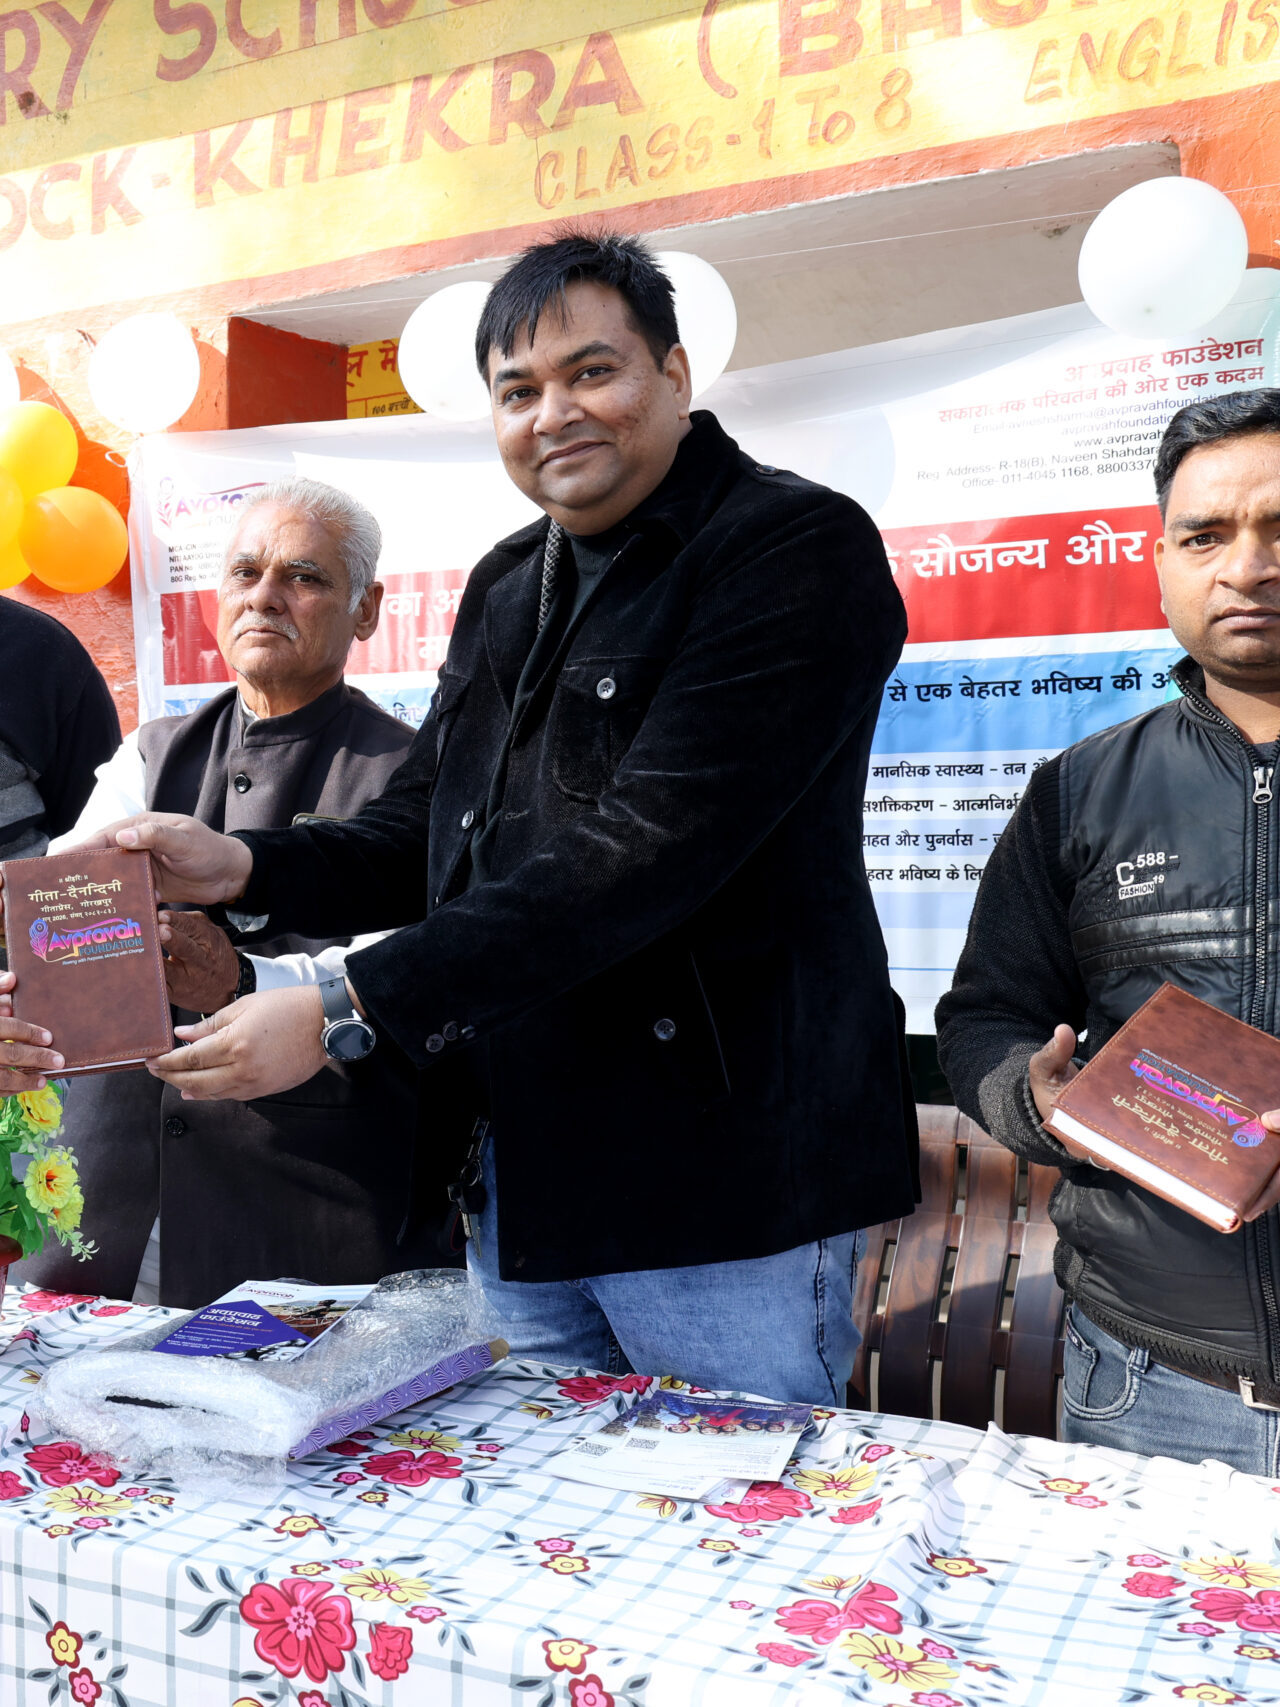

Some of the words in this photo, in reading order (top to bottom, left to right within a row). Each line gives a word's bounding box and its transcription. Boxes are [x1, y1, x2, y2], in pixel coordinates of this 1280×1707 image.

[873, 67, 914, 137] 8
[1162, 336, 1265, 367] फाउंडेशन
[1105, 378, 1127, 399] की
[1134, 373, 1169, 396] ओर
[1176, 372, 1210, 391] एक
[1215, 366, 1265, 386] कदम
[1051, 451, 1098, 465] Naveen
[911, 533, 1048, 579] सौजन्य
[1064, 519, 1147, 567] और
[888, 680, 908, 703] से
[914, 682, 951, 703] एक
[959, 669, 1021, 700] बेहतर
[1030, 667, 1103, 698] भविष्य
[1111, 665, 1143, 692] की
[872, 760, 930, 778] मानसिक
[935, 763, 985, 778] स्वास्थ्य
[1003, 762, 1026, 776] तन
[895, 829, 920, 847] और
[924, 829, 974, 851] पुनर्वास
[899, 864, 941, 882] भविष्य
[946, 864, 960, 881] के
[48, 917, 142, 957] Avpravah
[78, 937, 144, 956] FOUNDATION
